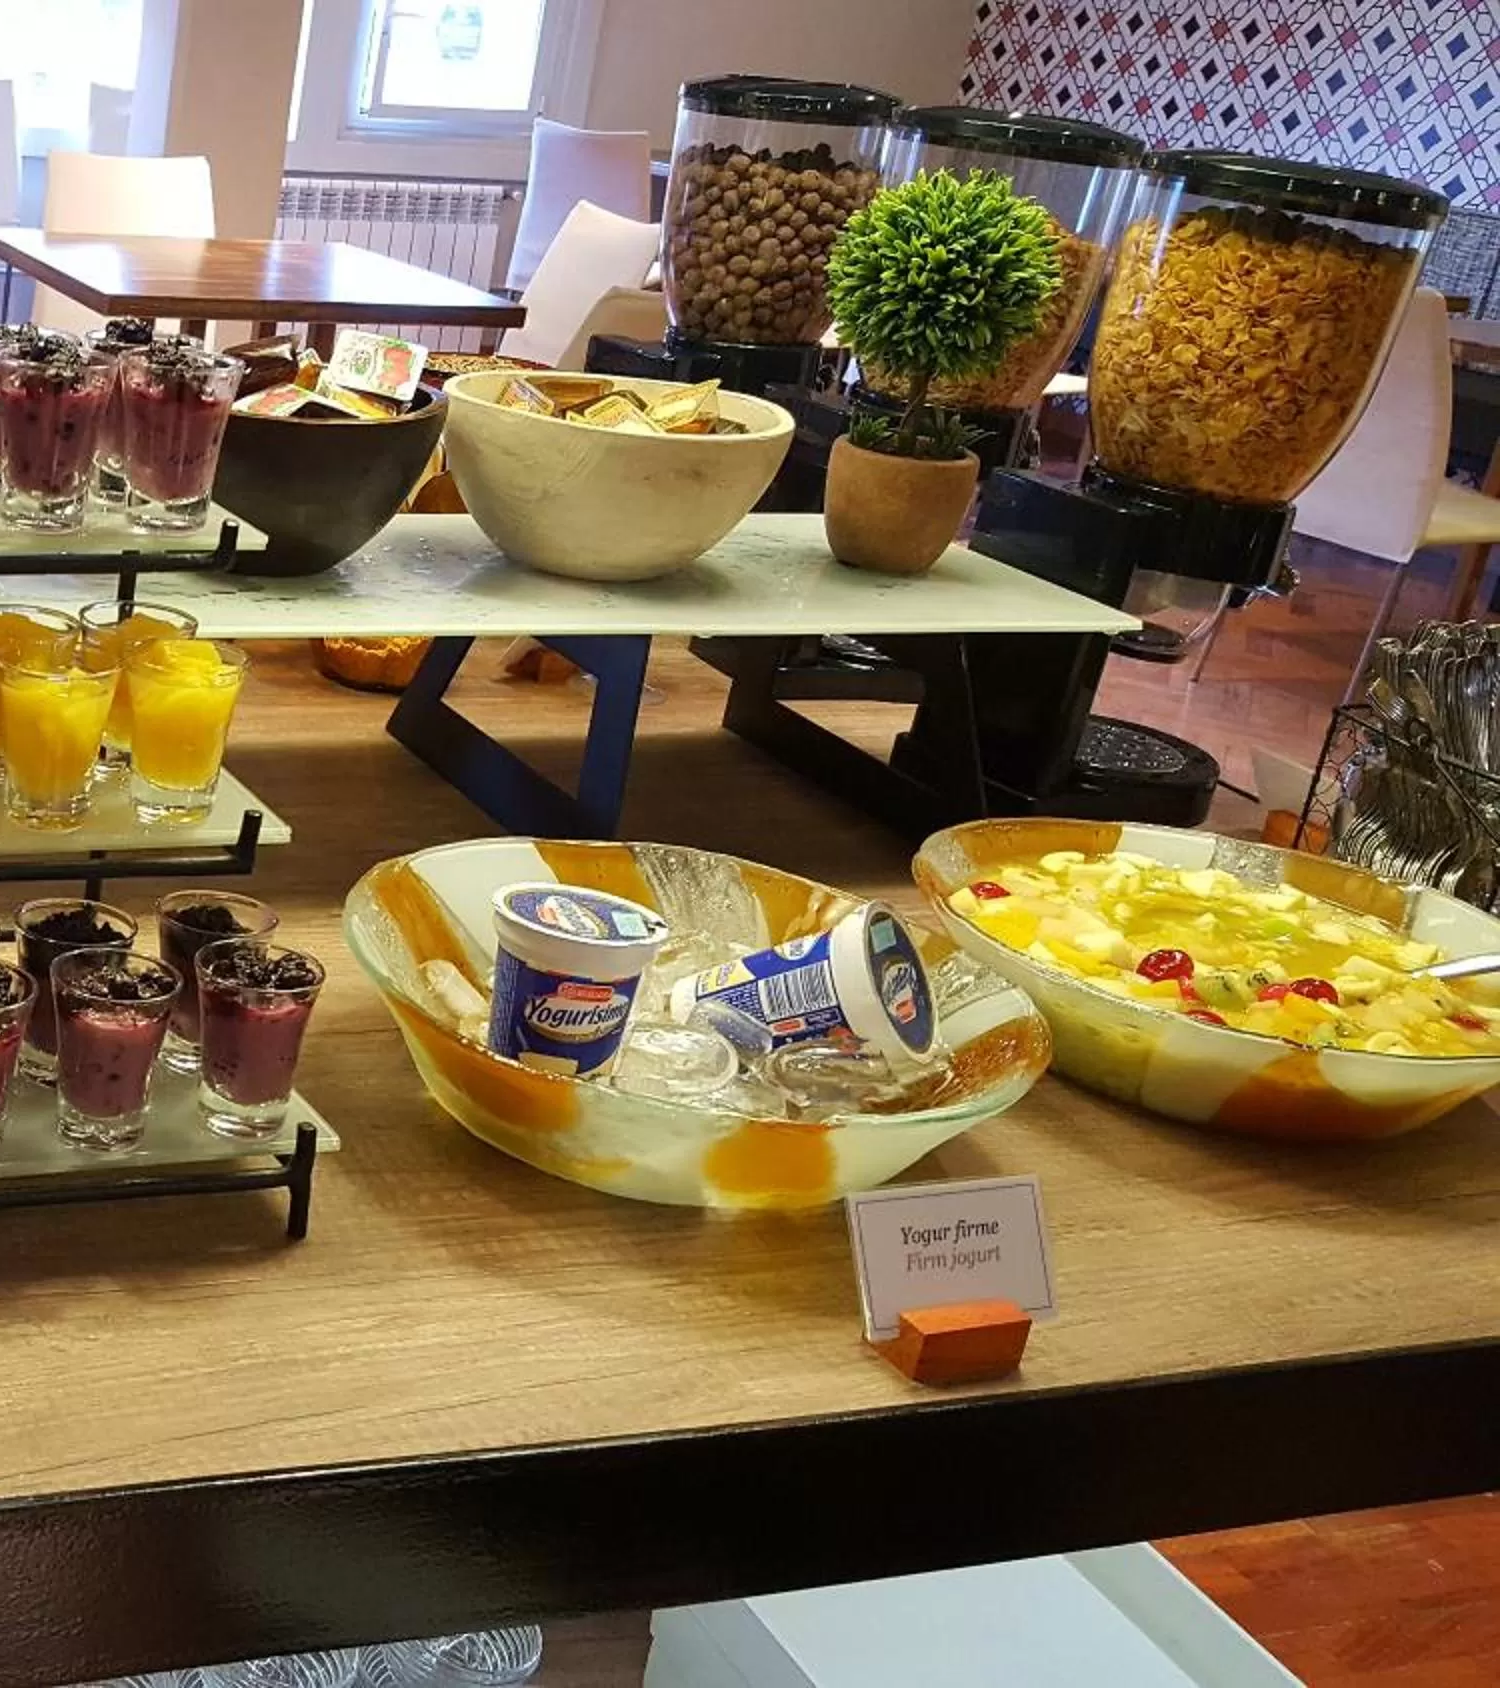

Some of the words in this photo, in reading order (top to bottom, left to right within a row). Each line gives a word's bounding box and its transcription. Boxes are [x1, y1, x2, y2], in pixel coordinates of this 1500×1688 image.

[900, 1226, 951, 1247] Yogur
[953, 1219, 1000, 1244] firme
[906, 1250, 948, 1273] Firm
[947, 1246, 1001, 1271] jogurt
